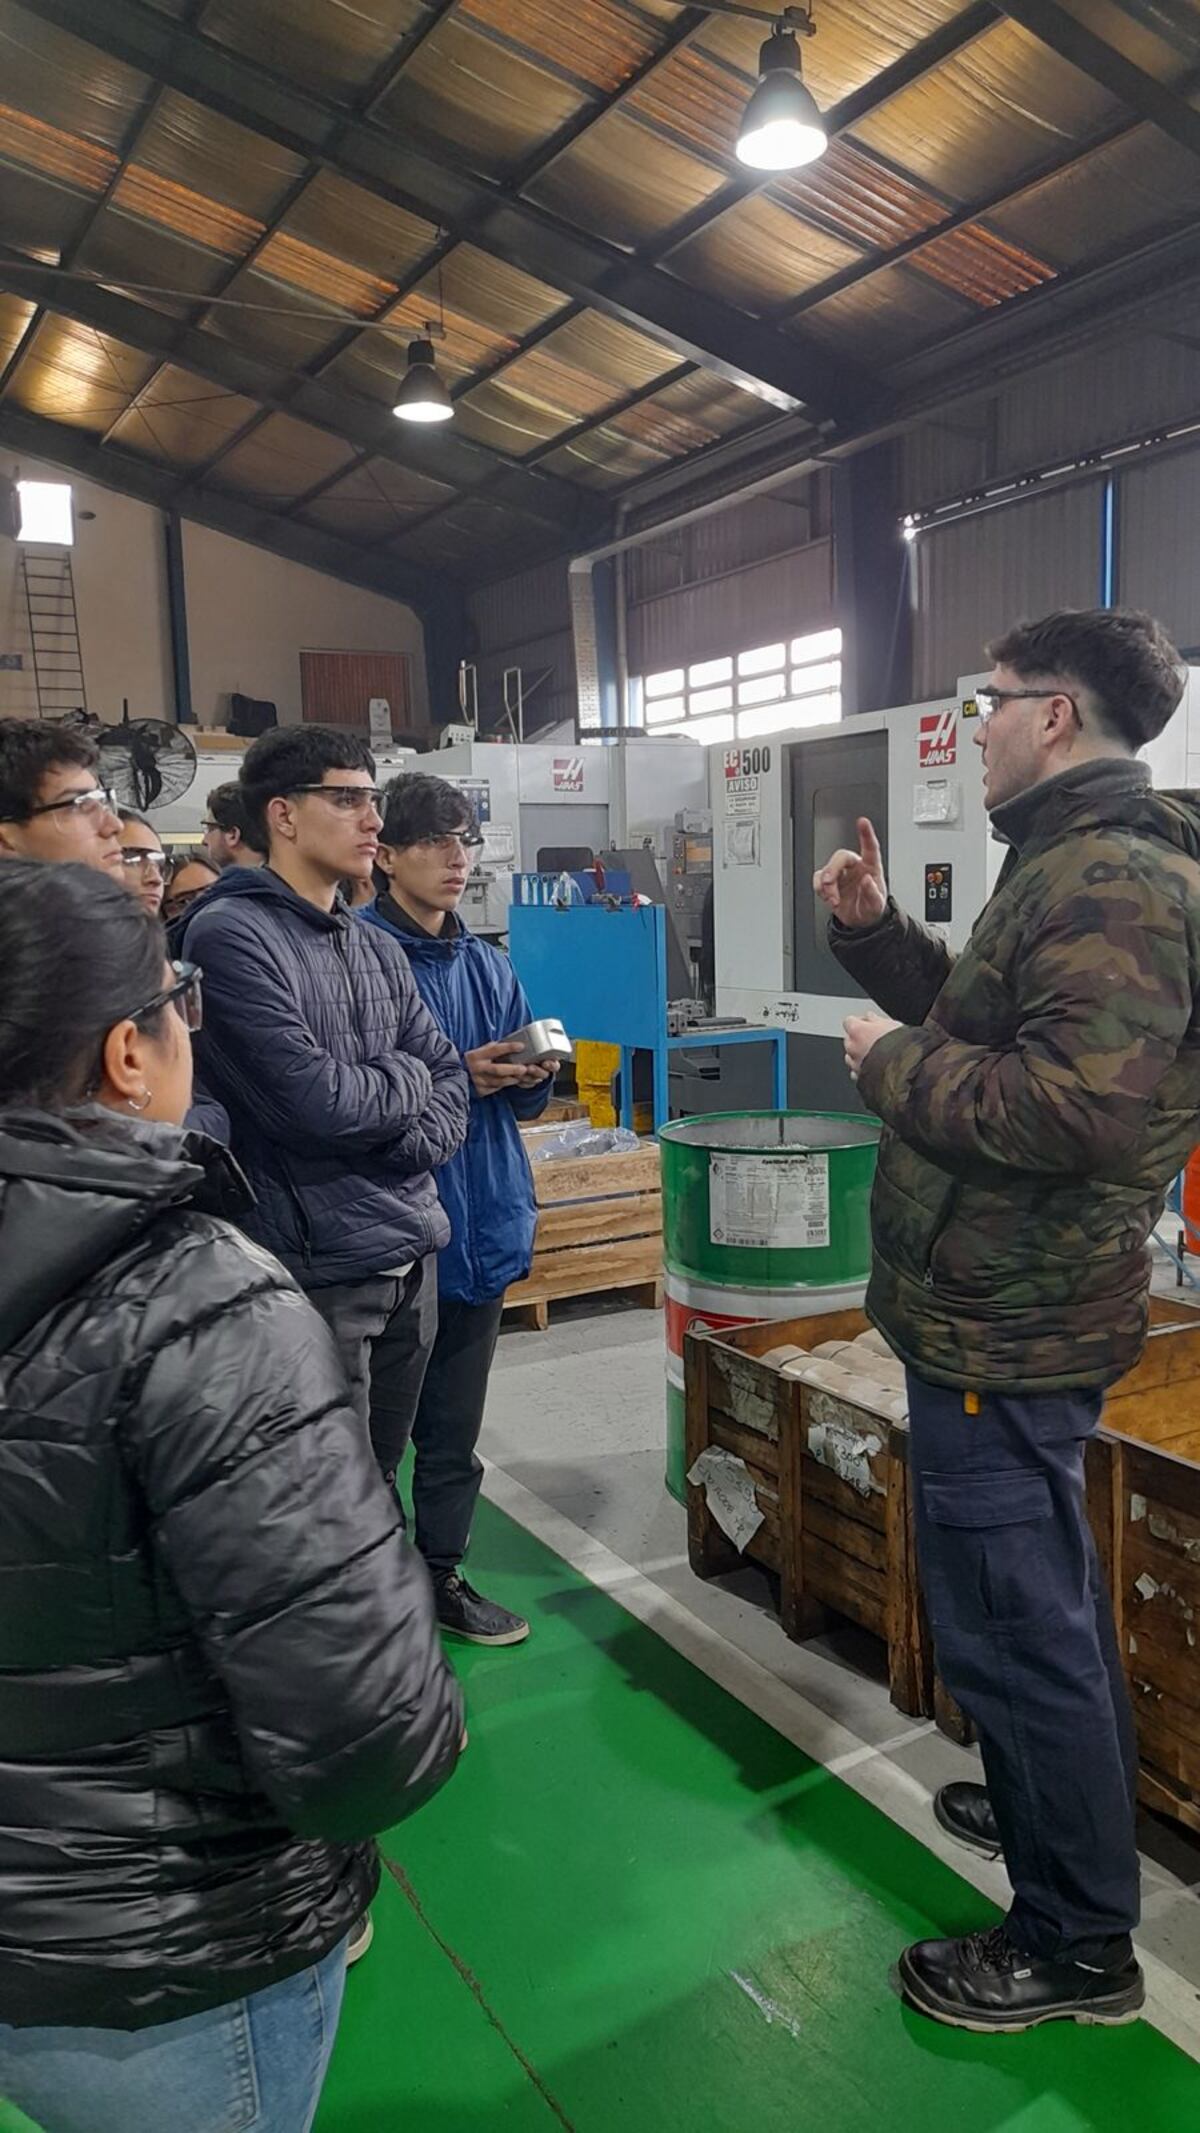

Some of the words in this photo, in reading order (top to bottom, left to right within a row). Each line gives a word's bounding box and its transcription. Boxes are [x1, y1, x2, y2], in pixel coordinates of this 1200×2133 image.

[743, 746, 770, 775] 500
[920, 748, 955, 765] HAAS
[728, 778, 758, 793] AVISO
